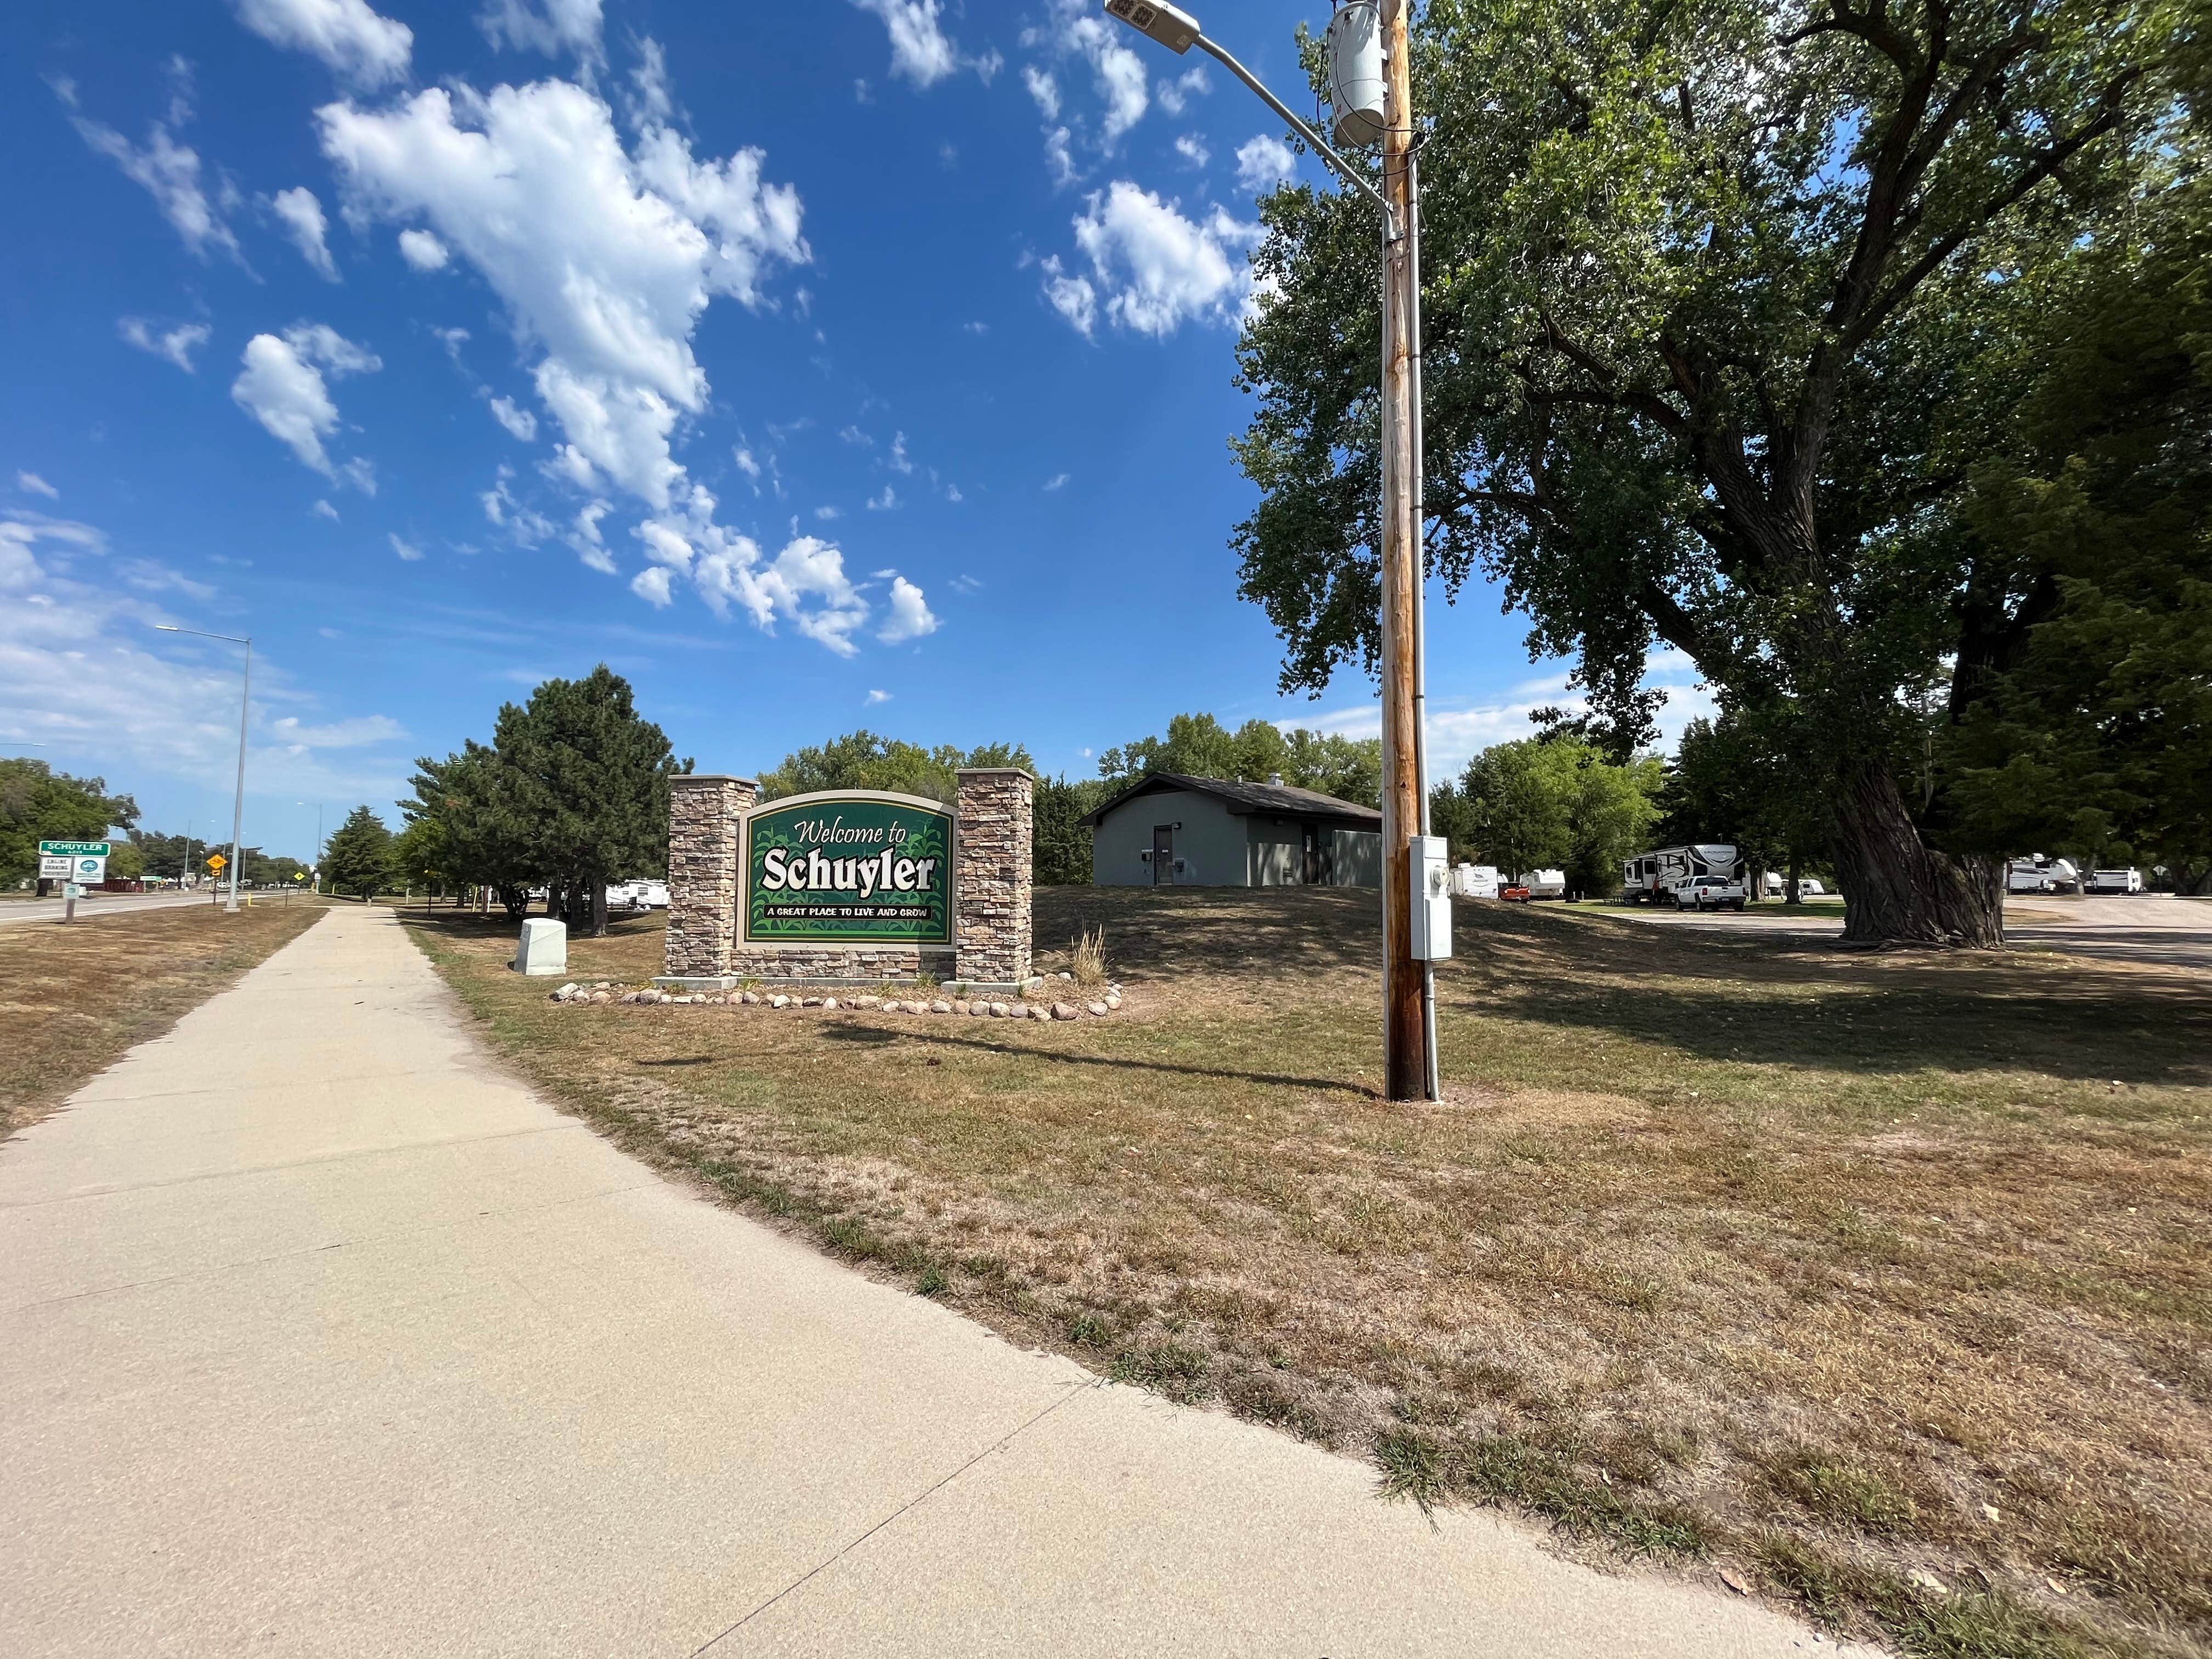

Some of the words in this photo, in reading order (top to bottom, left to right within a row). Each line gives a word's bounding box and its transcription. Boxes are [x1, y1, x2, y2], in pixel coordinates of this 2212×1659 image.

[794, 816, 883, 843] Welcome
[888, 821, 906, 843] to
[47, 843, 103, 851] SCHUYLER
[761, 845, 936, 899] Schuyler
[768, 907, 775, 916] A
[777, 907, 807, 916] GREAT
[854, 907, 874, 916] LIVE
[877, 908, 898, 916] AND
[900, 909, 927, 917] GROW
